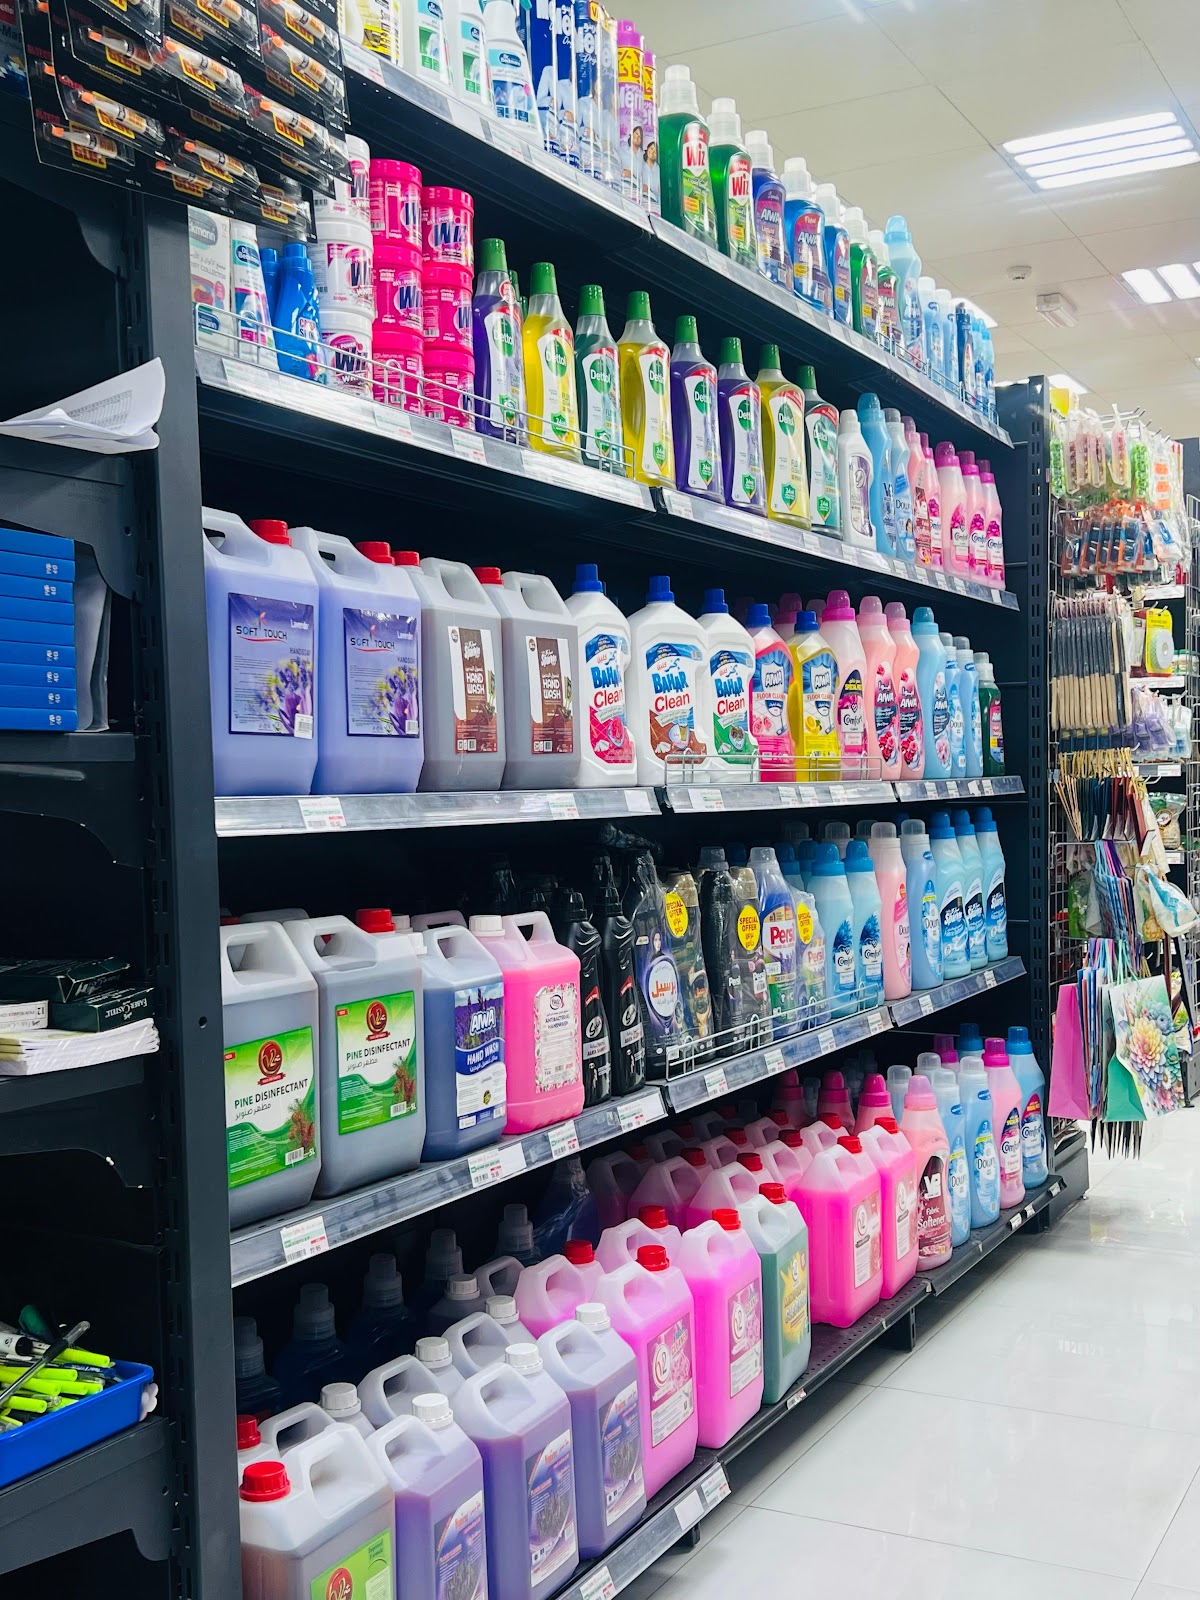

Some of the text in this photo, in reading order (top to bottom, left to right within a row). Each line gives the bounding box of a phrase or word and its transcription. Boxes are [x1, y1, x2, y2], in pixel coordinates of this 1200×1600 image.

[686, 143, 705, 167] Wiz
[732, 173, 749, 196] Wiz
[493, 328, 514, 346] Dettol
[546, 350, 567, 367] Dettol
[590, 368, 611, 384] Dettol
[290, 619, 309, 630] Lavender
[236, 626, 288, 640] SOFT TOUCH
[350, 637, 395, 649] SOFT TOUCH
[466, 673, 484, 684] HAND
[543, 679, 560, 689] HAND
[591, 666, 622, 690] BAHAR
[652, 671, 689, 695] BAHAR
[467, 684, 485, 695] WASH
[543, 690, 561, 699] WASH
[714, 676, 745, 699] BAHAR
[594, 689, 623, 709] Clean
[655, 693, 690, 712] Clean
[877, 692, 894, 704] AIWA
[900, 697, 917, 709] AIWA
[717, 697, 746, 715] Clean
[934, 700, 948, 711] AIWA
[843, 715, 862, 727] Comfort
[666, 900, 683, 912] SPECIAL
[669, 909, 683, 919] OFFER
[740, 916, 758, 926] SPECIAL
[798, 911, 811, 921] SPECIAL
[742, 923, 757, 932] OFFER
[800, 919, 811, 927] OFFER
[651, 980, 677, 999] برسيل
[37, 1006, 45, 1015] 12
[105, 998, 148, 1018] FABER-CASTELL
[470, 1008, 497, 1036] AIWA
[346, 1038, 411, 1061] PINE DISINFECTANT
[467, 1042, 500, 1066] HAND WASH
[234, 1096, 254, 1109] PINE
[255, 1079, 308, 1103] DISINFECTANT
[926, 1206, 940, 1216] Fabric
[917, 1214, 946, 1231] Softener
